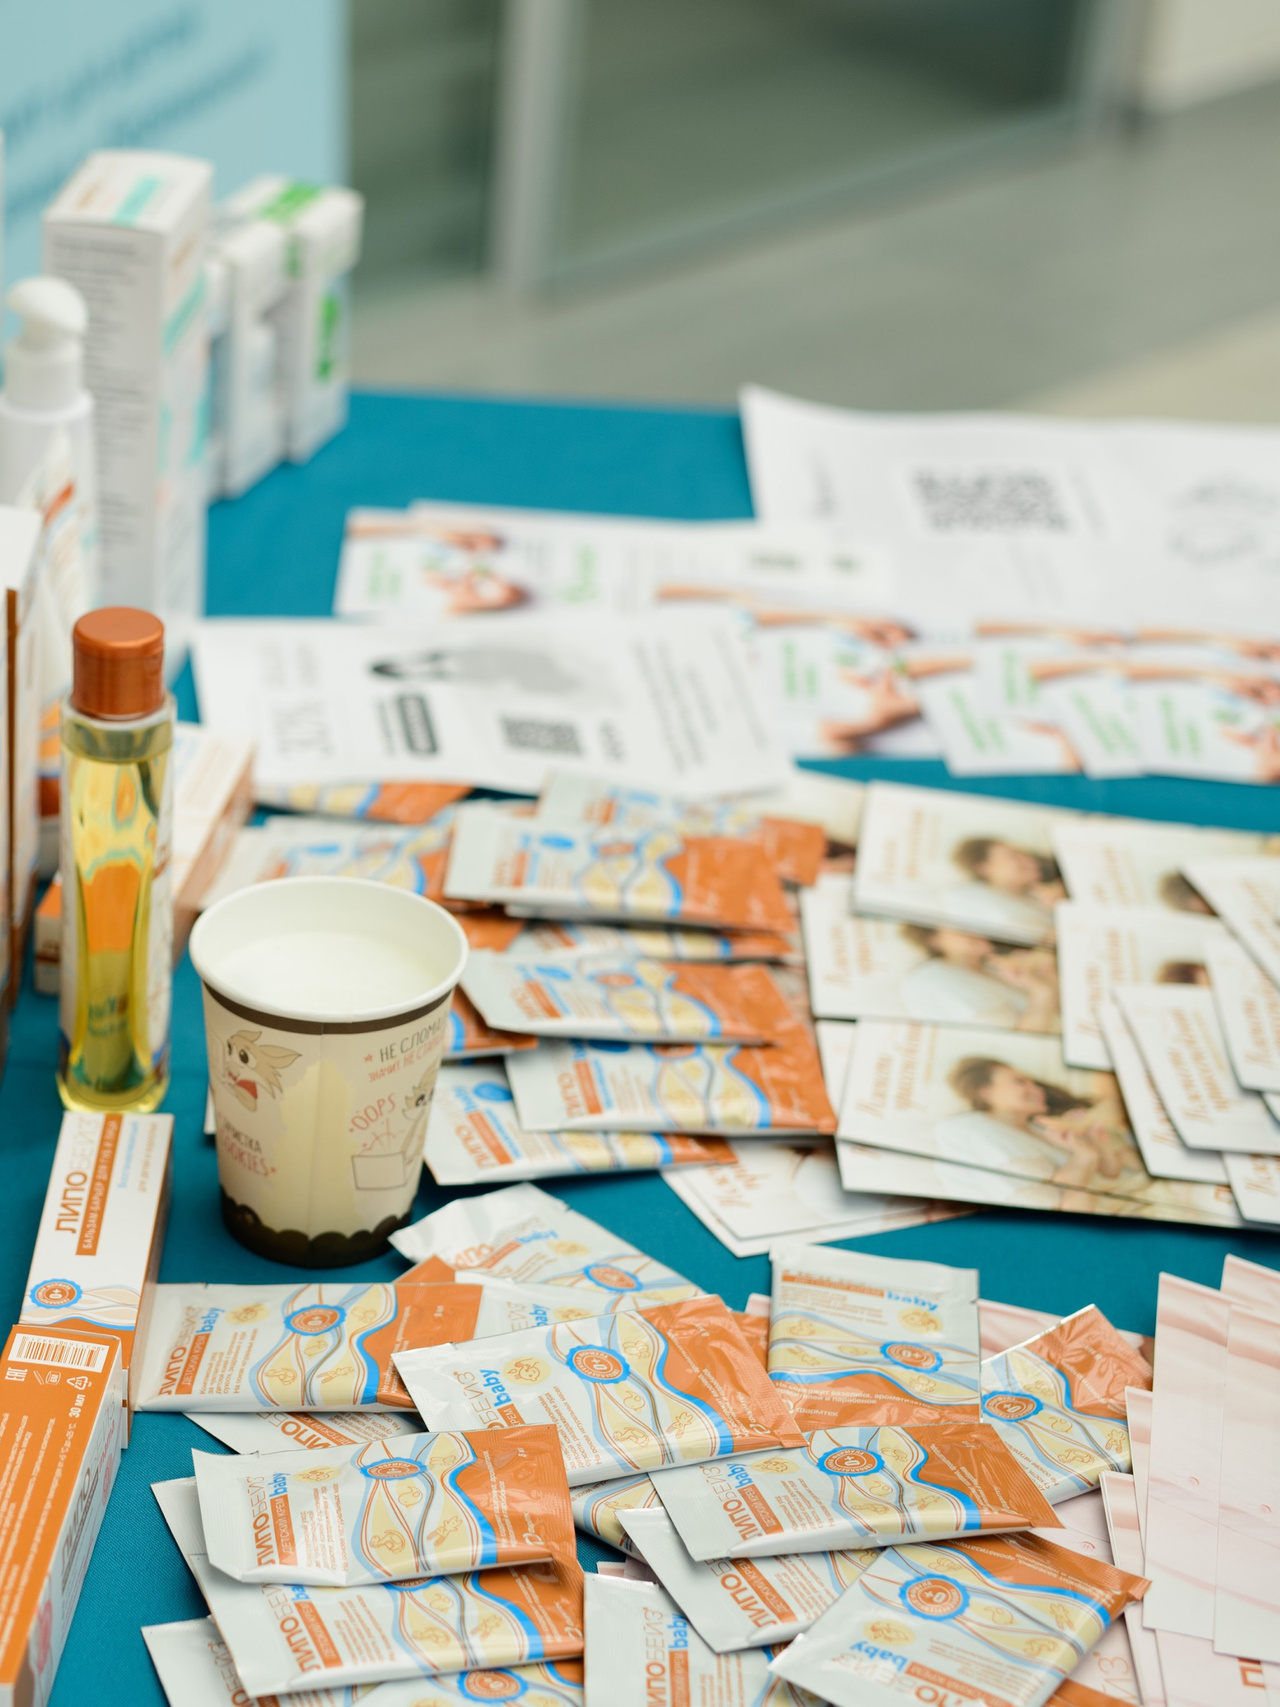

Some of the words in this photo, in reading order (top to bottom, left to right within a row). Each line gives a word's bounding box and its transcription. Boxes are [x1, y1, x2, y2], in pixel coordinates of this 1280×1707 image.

[368, 1060, 401, 1083] ЗНАЧИТ
[403, 1052, 415, 1067] НЕ
[379, 1045, 397, 1063] НЕ
[887, 1291, 939, 1312] baby
[195, 1306, 225, 1335] baby
[181, 1354, 200, 1384] ДЕТСКИЙ
[192, 1335, 206, 1352] КРЕМ
[477, 1367, 513, 1407] baby
[268, 1471, 291, 1497] baby
[725, 1462, 754, 1490] baby
[274, 1496, 286, 1517] КРЕМ
[740, 1486, 762, 1501] КРЕМ
[245, 1475, 276, 1567] ЛИПОБЕЙЗ
[751, 1501, 778, 1526] ДЕТСКИЙ
[276, 1516, 292, 1554] ДЕТСКИЙ
[750, 1580, 788, 1612] ДЕТСКИЙ
[849, 1639, 909, 1673] baby
